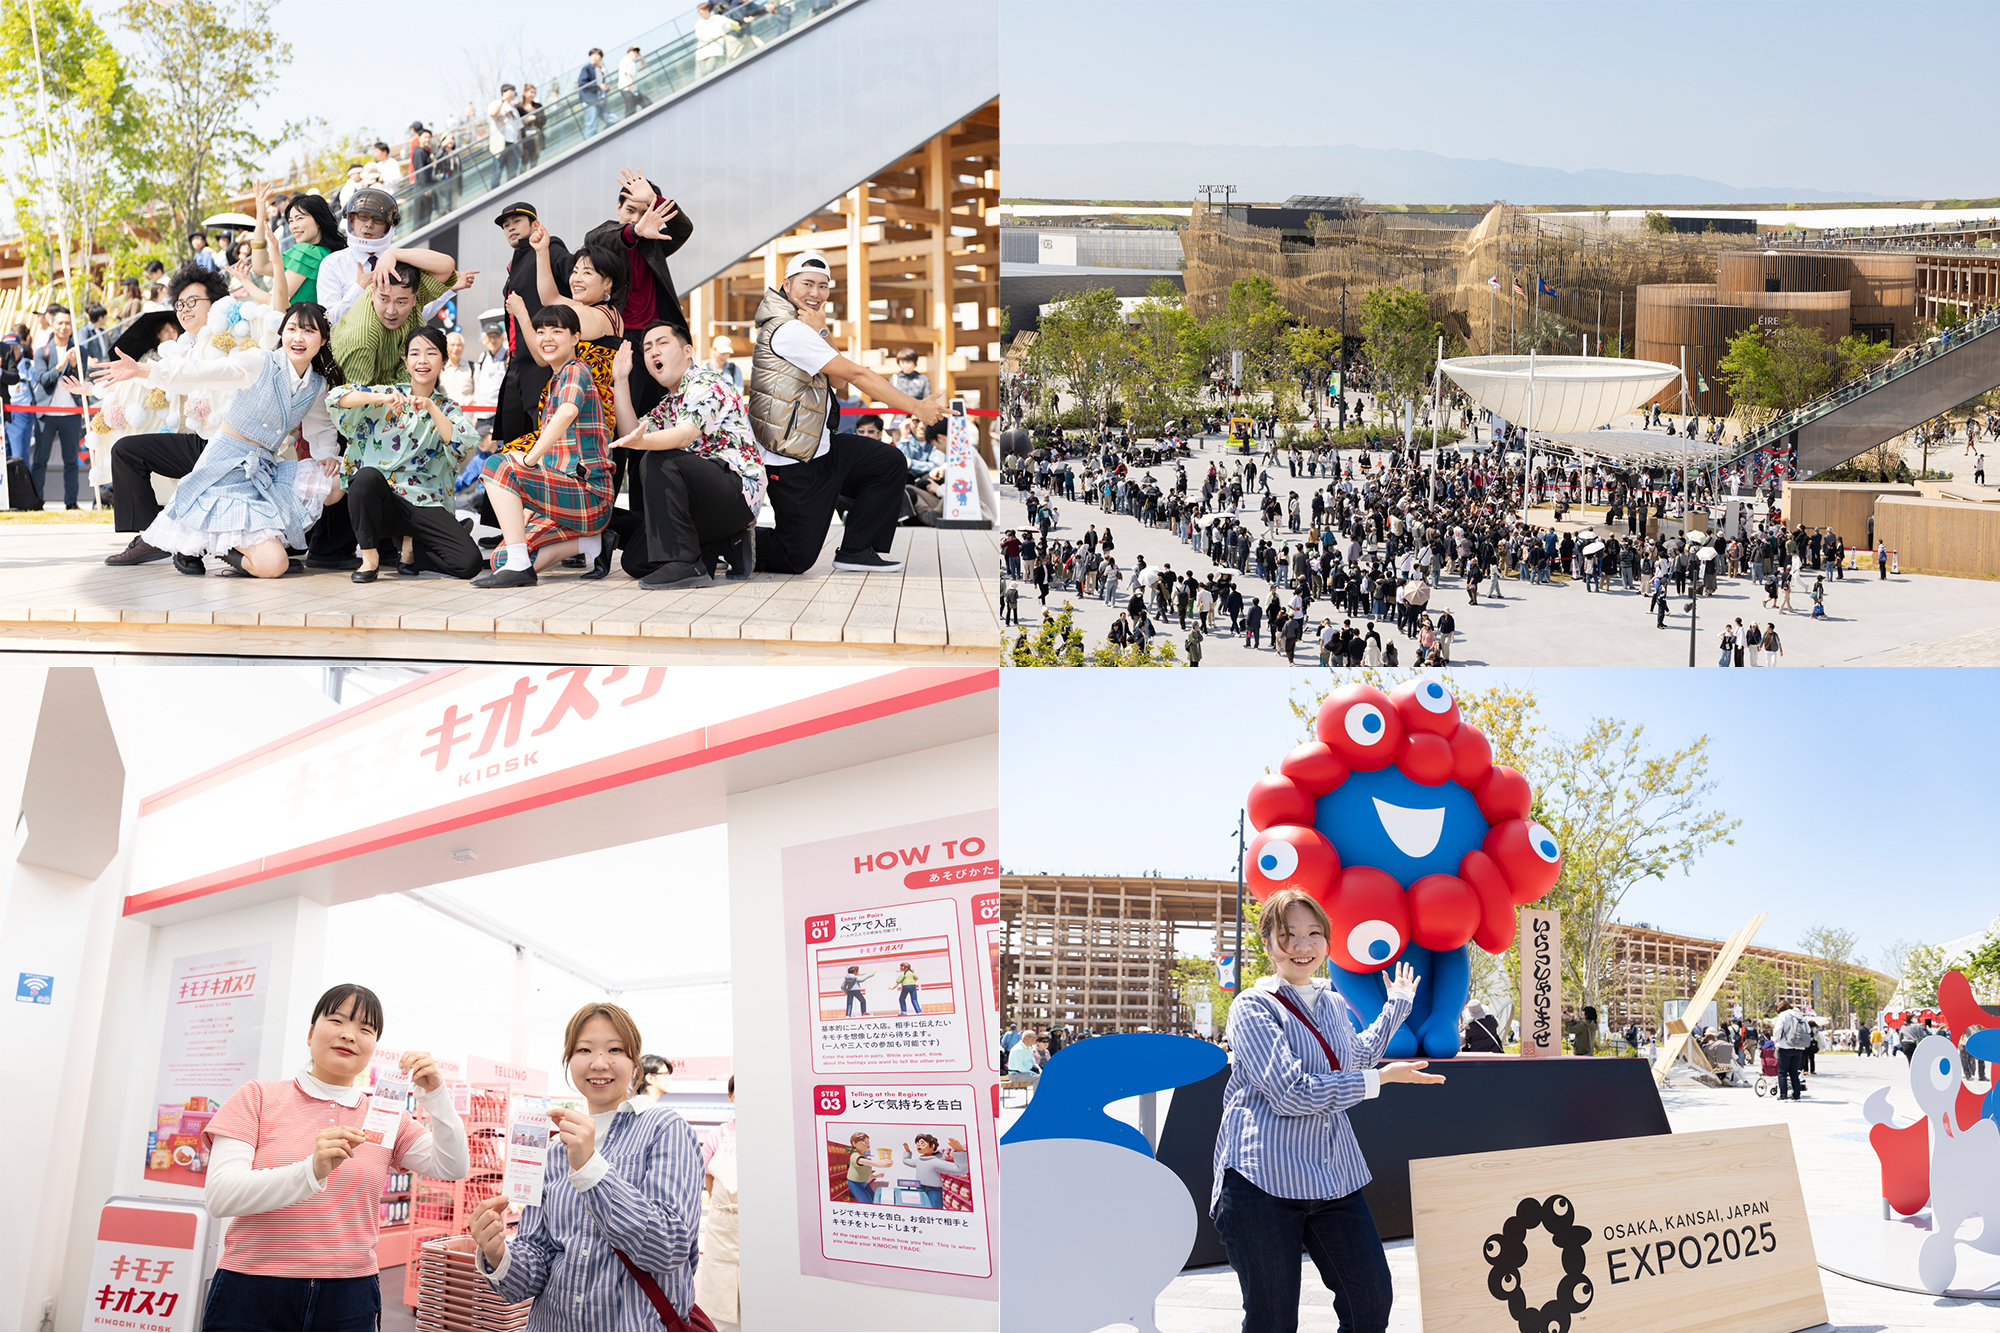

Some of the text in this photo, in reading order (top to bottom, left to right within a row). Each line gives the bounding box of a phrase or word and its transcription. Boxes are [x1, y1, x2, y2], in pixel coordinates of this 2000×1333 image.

[1758, 314, 1779, 325] ÉIRE
[458, 750, 539, 788] KIOSK
[854, 837, 986, 874] HOW TO
[928, 865, 994, 883] あそびかた
[811, 920, 829, 928] STEP
[840, 917, 896, 932] ペアで入店
[811, 926, 829, 939] 01
[859, 944, 904, 953] キモチキオスク
[178, 973, 257, 999] キモチキオスク
[821, 1030, 932, 1041] キモチを想像しながら待ちます。
[494, 1064, 527, 1081] TELLING
[820, 1098, 841, 1110] 03
[852, 1099, 962, 1111] レジで気持ちを告白
[832, 1208, 969, 1228] レジでキモチを告白。お会計で相手と
[832, 1218, 923, 1234] キモチをトレードします。
[1603, 1200, 1770, 1241] OSAKA, KANSAI, JAPAN
[849, 1233, 871, 1241] register,
[900, 1245, 922, 1253] TRADE.
[1606, 1221, 1777, 1285] EXPO2025
[110, 1254, 175, 1284] キモチ
[95, 1284, 179, 1317] キオスク
[94, 1316, 171, 1332] KIMOCHI KIOSK
